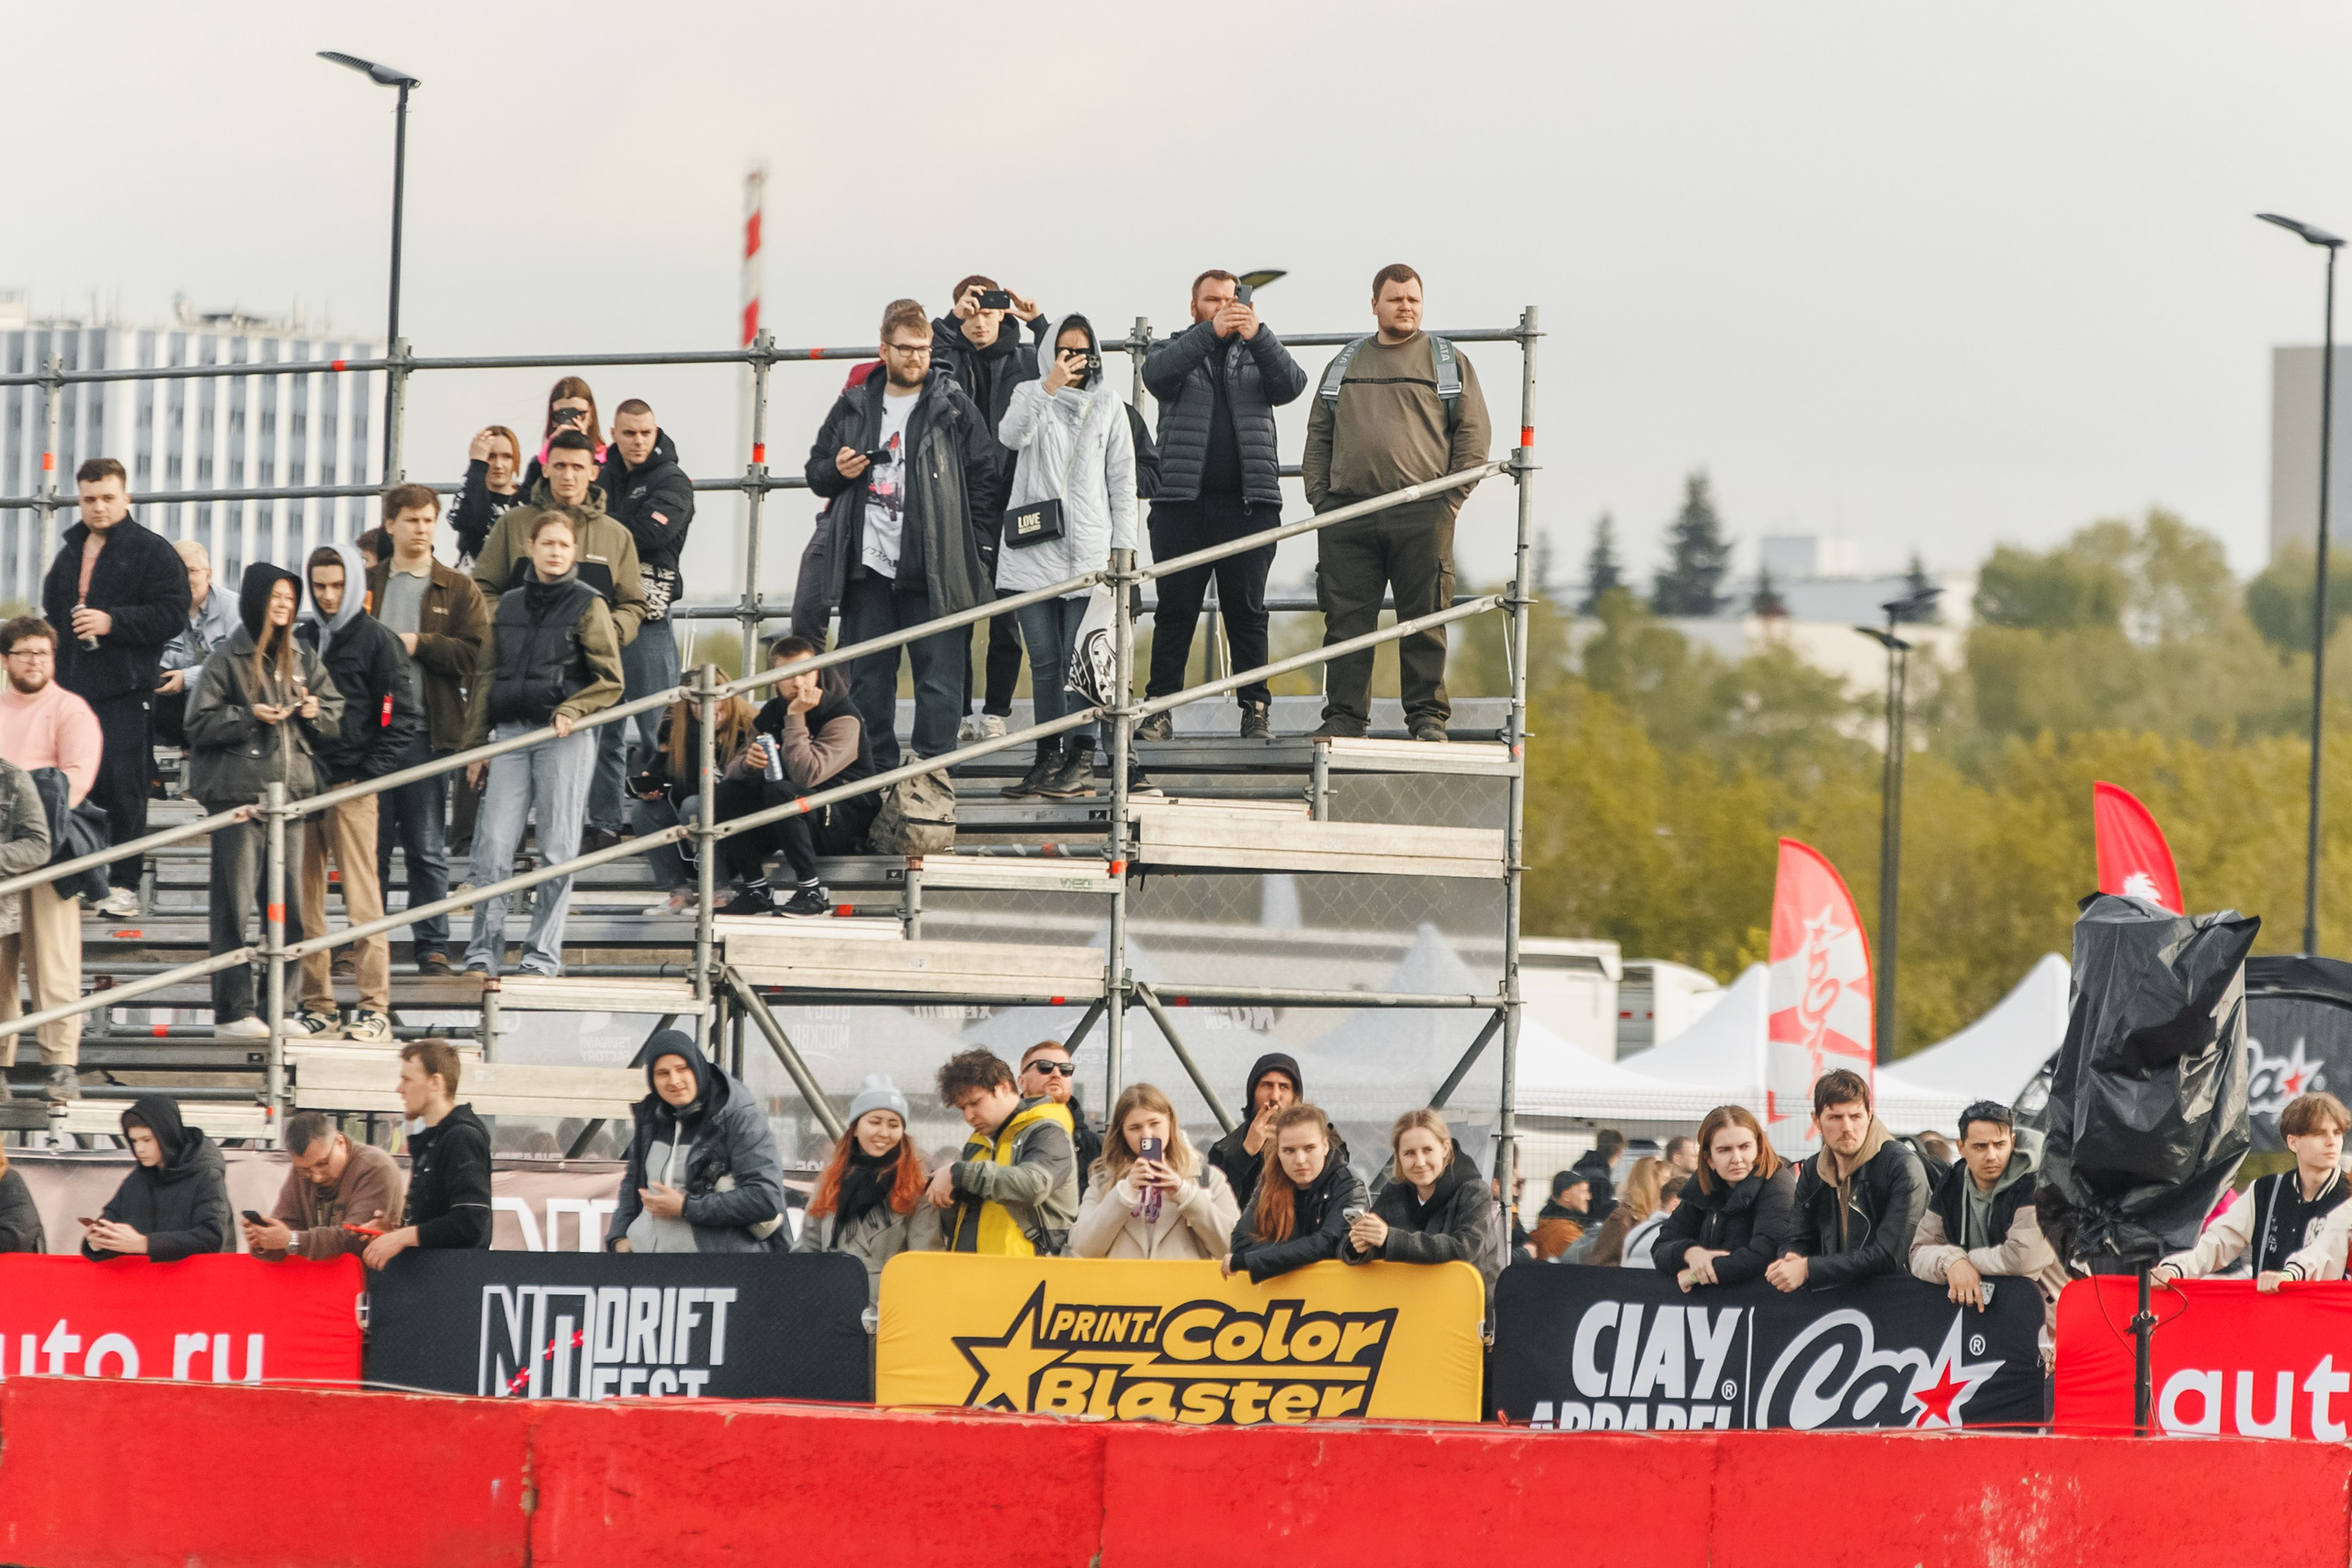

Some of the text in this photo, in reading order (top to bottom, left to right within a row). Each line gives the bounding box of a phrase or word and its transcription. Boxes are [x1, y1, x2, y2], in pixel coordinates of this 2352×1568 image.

[1017, 511, 1042, 529] LOVE
[594, 1287, 738, 1366] DRIFT
[1162, 1307, 1387, 1363] Color
[1035, 1367, 1366, 1425] Blaster
